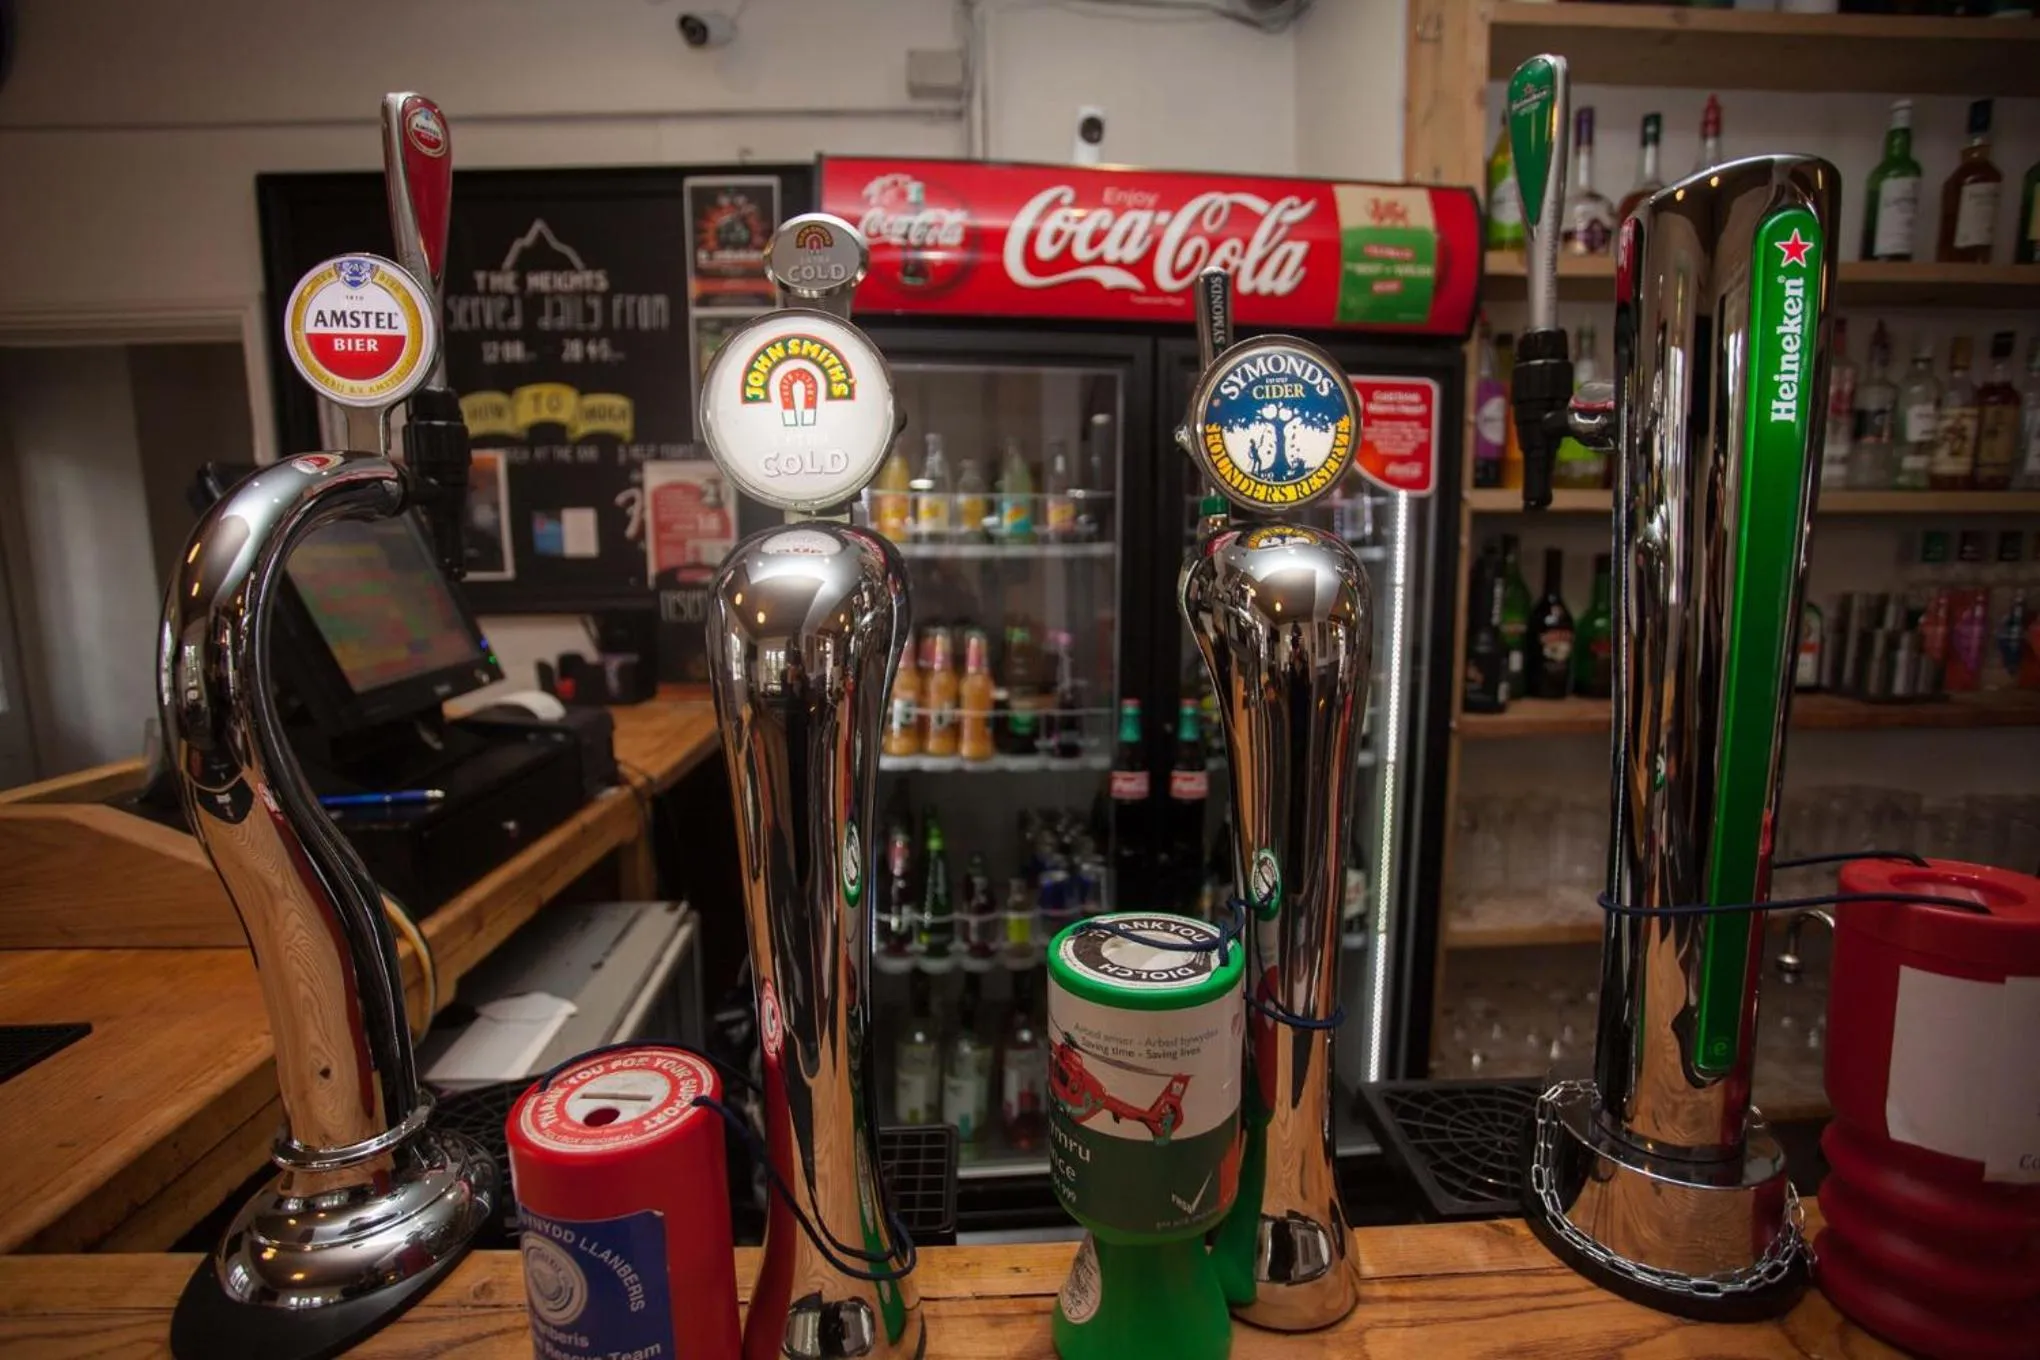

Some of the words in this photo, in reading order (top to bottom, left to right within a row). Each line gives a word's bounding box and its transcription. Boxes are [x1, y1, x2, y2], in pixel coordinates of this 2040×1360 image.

[1102, 187, 1158, 207] Enjoy
[1003, 185, 1316, 296] Coca-Cola
[787, 263, 846, 282] COLD
[314, 310, 398, 330] AMSTEL
[1210, 276, 1226, 344] SYMONDS
[333, 338, 379, 352] BIER
[1771, 277, 1804, 422] Heineken
[746, 343, 786, 400] JOHN
[1220, 354, 1334, 400] SYMONDS
[1252, 384, 1306, 399] CIDER
[764, 449, 850, 478] COLD
[1295, 424, 1350, 498] RESERVE
[1168, 923, 1211, 942] YOU
[1097, 963, 1196, 981] DIOLCH
[1112, 1047, 1136, 1058] time
[1146, 1049, 1179, 1061] Saving
[565, 1064, 605, 1086] YOU
[654, 1057, 693, 1080] YOUR
[643, 1078, 698, 1132] SUPPORT
[578, 1236, 647, 1313] LLANBERIS
